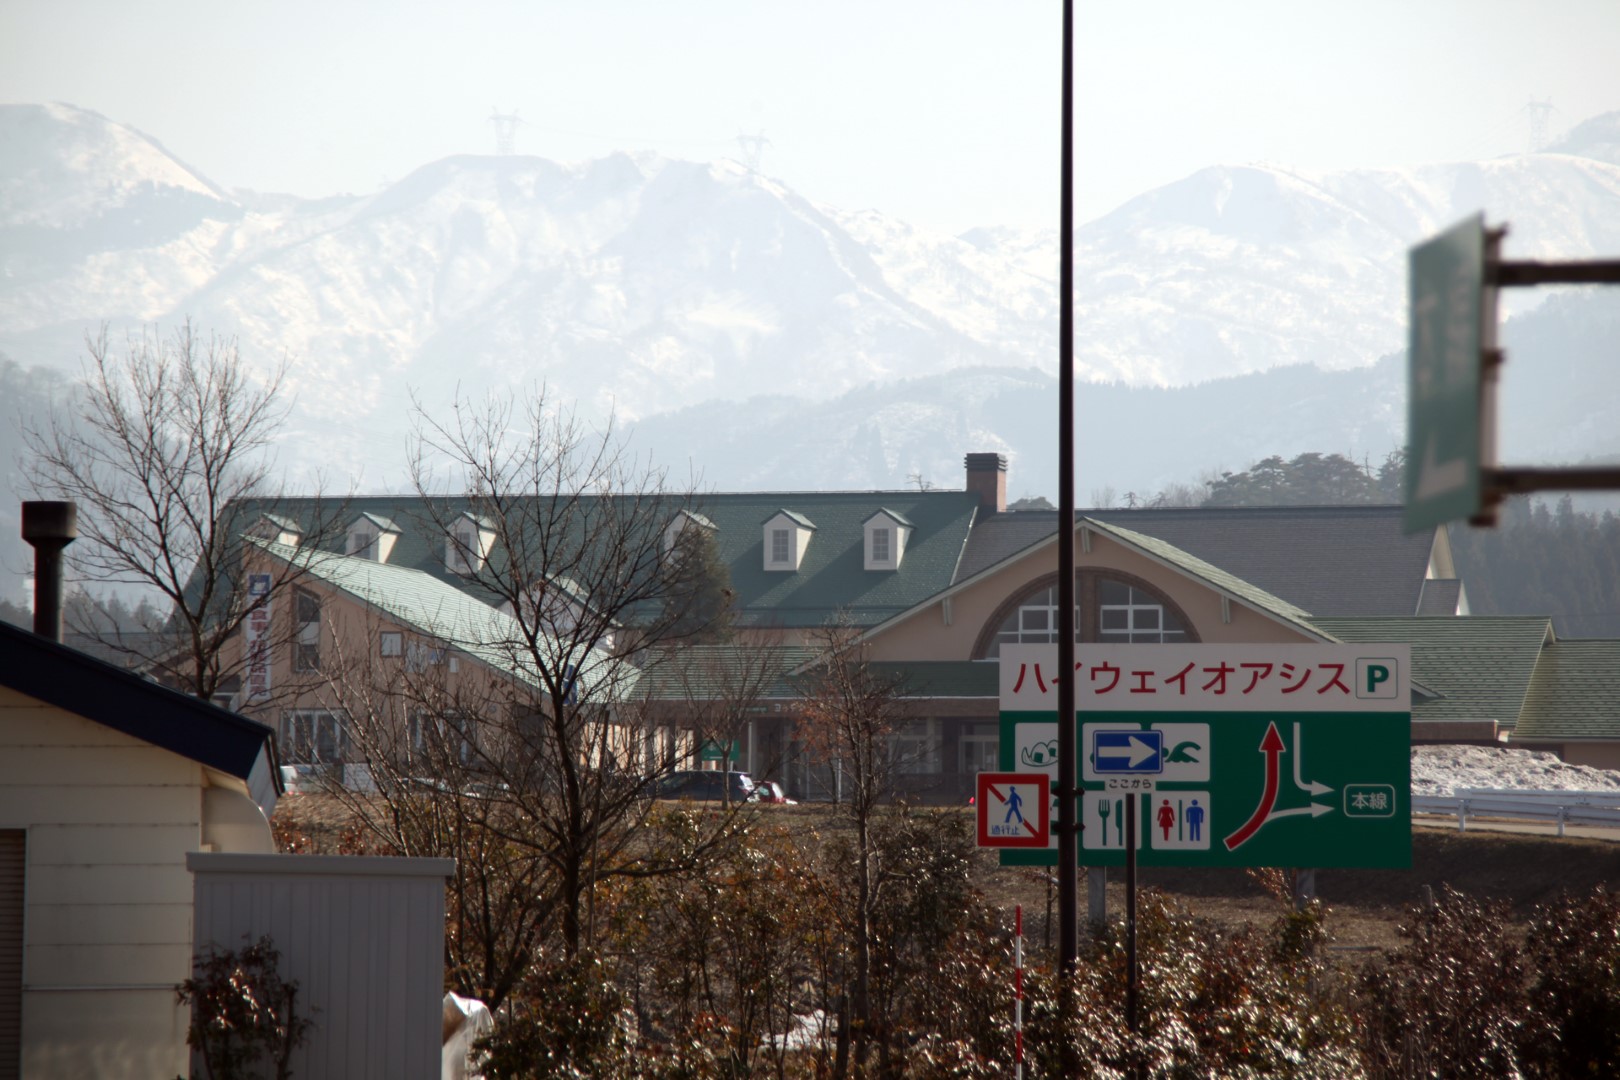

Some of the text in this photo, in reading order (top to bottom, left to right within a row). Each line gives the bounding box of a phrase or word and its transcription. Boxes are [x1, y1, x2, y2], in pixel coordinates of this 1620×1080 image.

[1367, 665, 1389, 692] P
[1109, 779, 1152, 789] ここから
[1351, 791, 1388, 810] 本線
